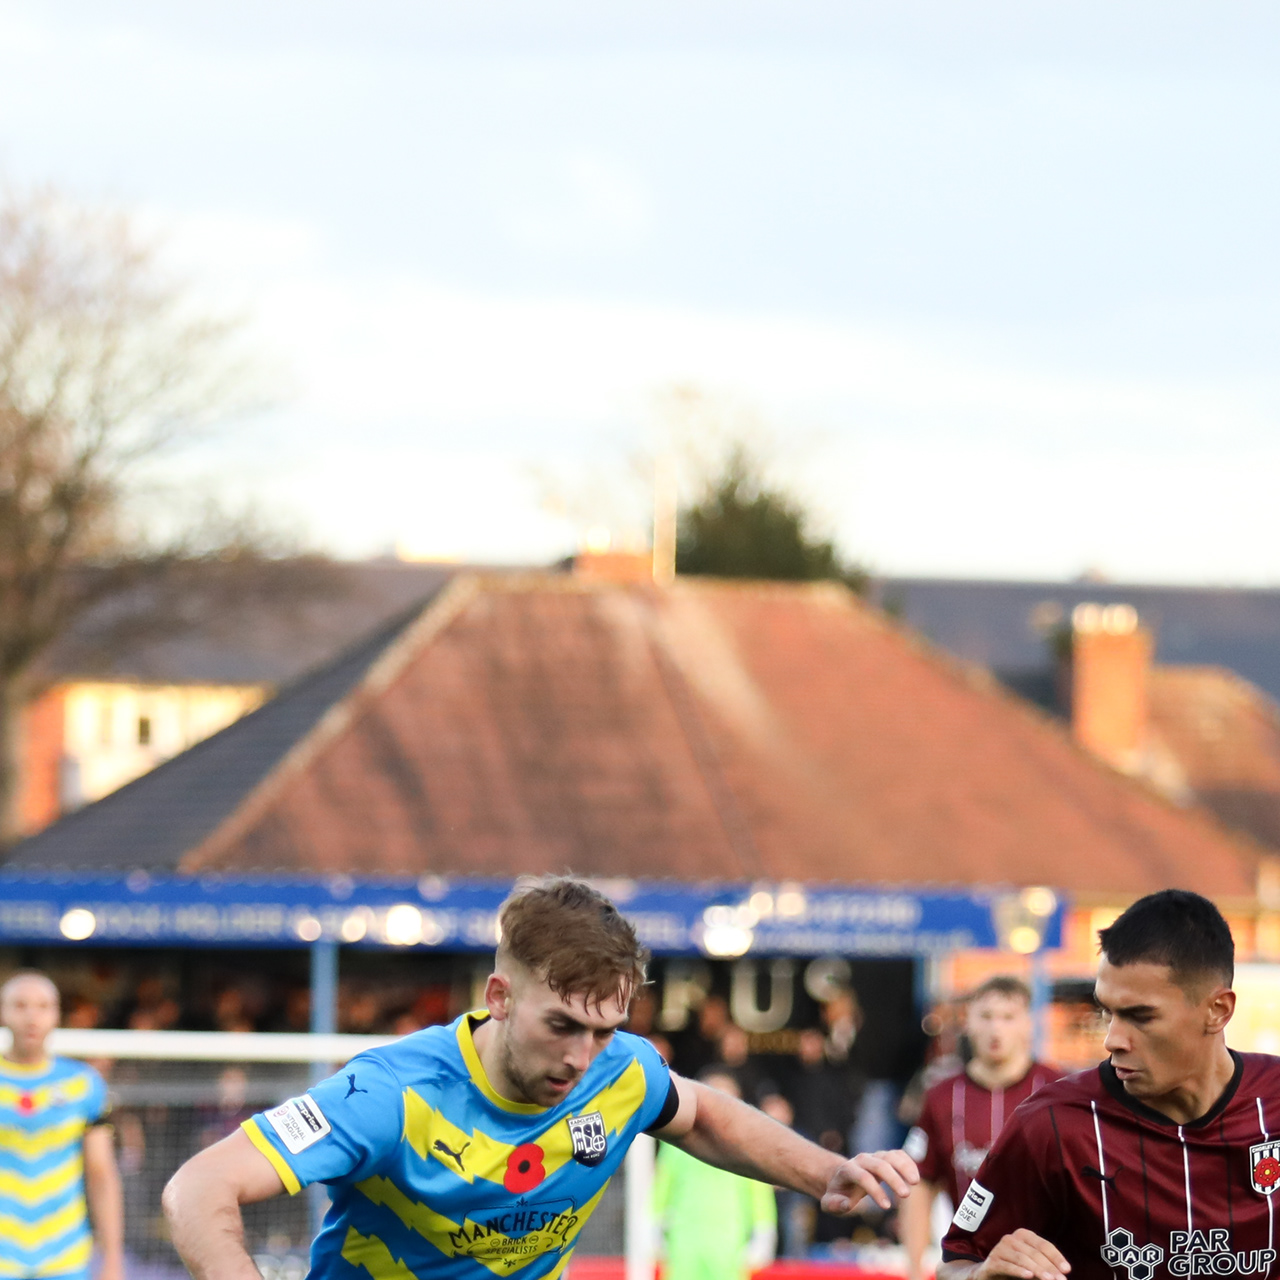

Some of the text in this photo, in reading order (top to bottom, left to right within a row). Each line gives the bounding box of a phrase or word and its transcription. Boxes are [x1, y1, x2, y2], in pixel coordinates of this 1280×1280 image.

[448, 1210, 578, 1248] MANCHESTER
[486, 1245, 538, 1255] SPECIALISTS
[502, 1236, 528, 1247] BRICK
[1170, 1229, 1230, 1253] PAR
[1107, 1250, 1156, 1262] PAR
[1168, 1249, 1276, 1277] GROUP
